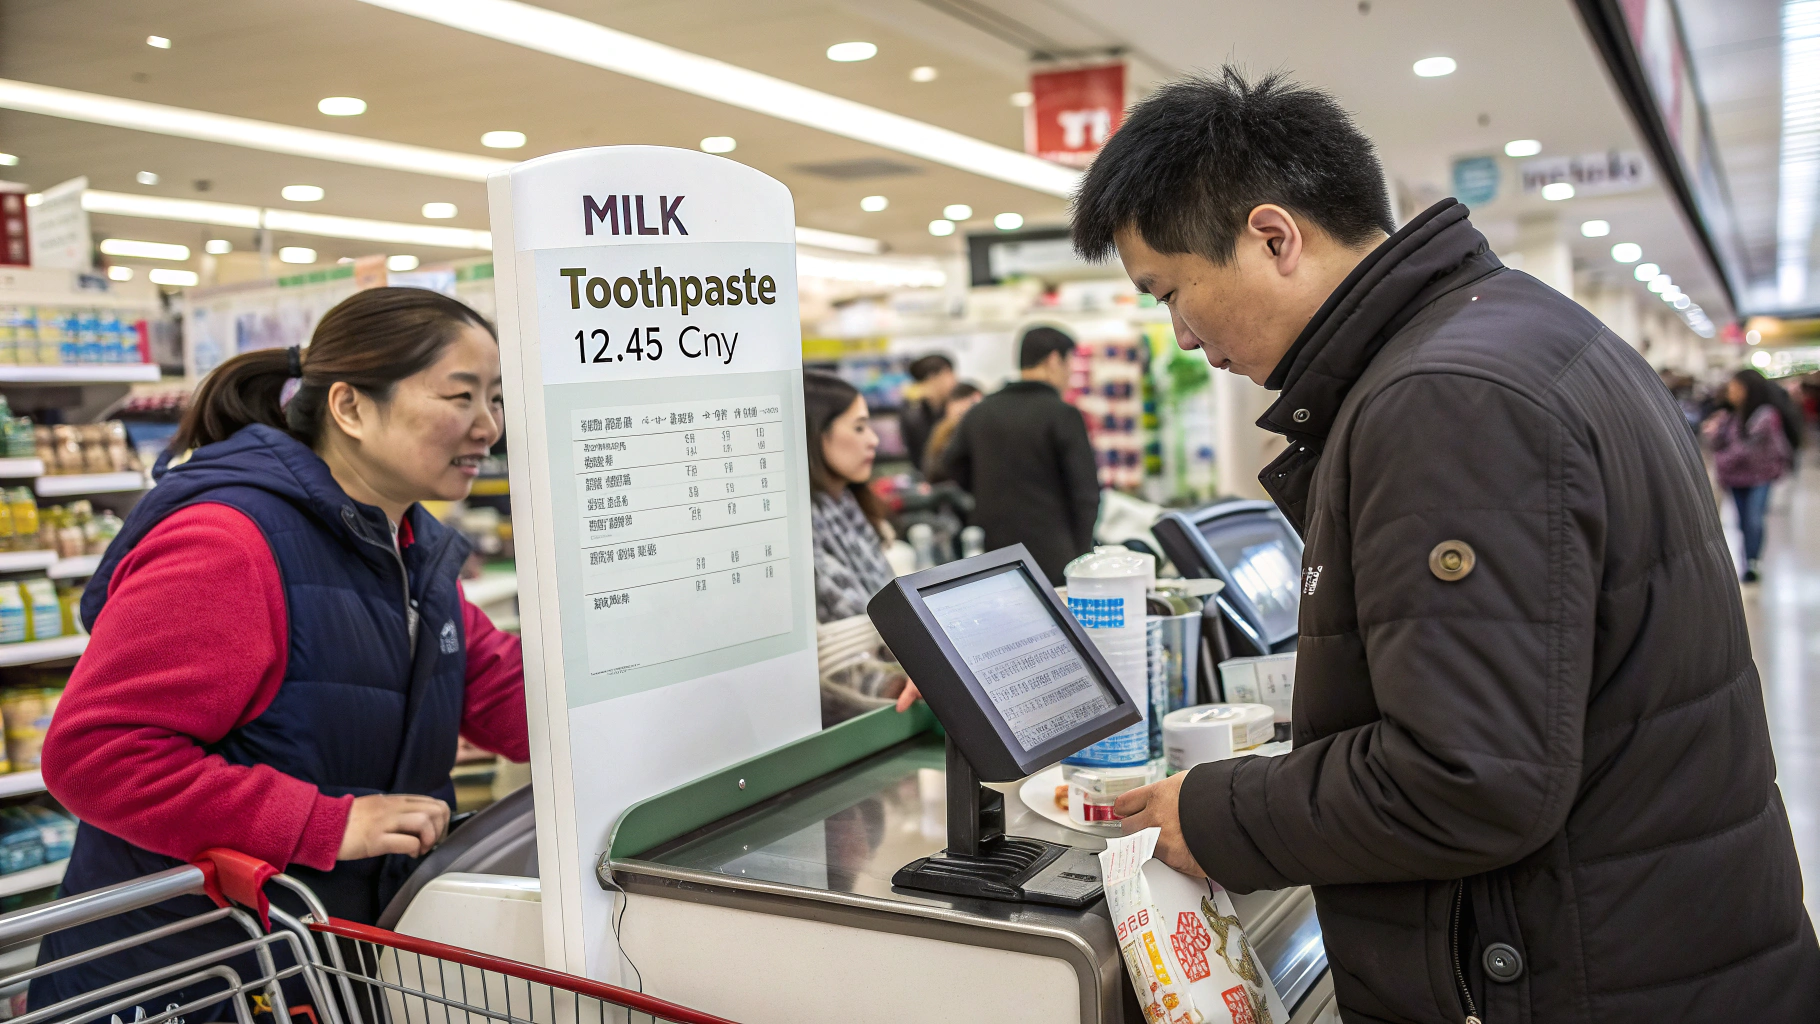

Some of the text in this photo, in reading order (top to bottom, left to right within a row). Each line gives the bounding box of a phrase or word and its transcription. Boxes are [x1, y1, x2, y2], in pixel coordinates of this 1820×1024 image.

[582, 195, 689, 236] MILK
[560, 266, 776, 316] Toothpaste
[575, 326, 739, 365] 12.45 Cny
